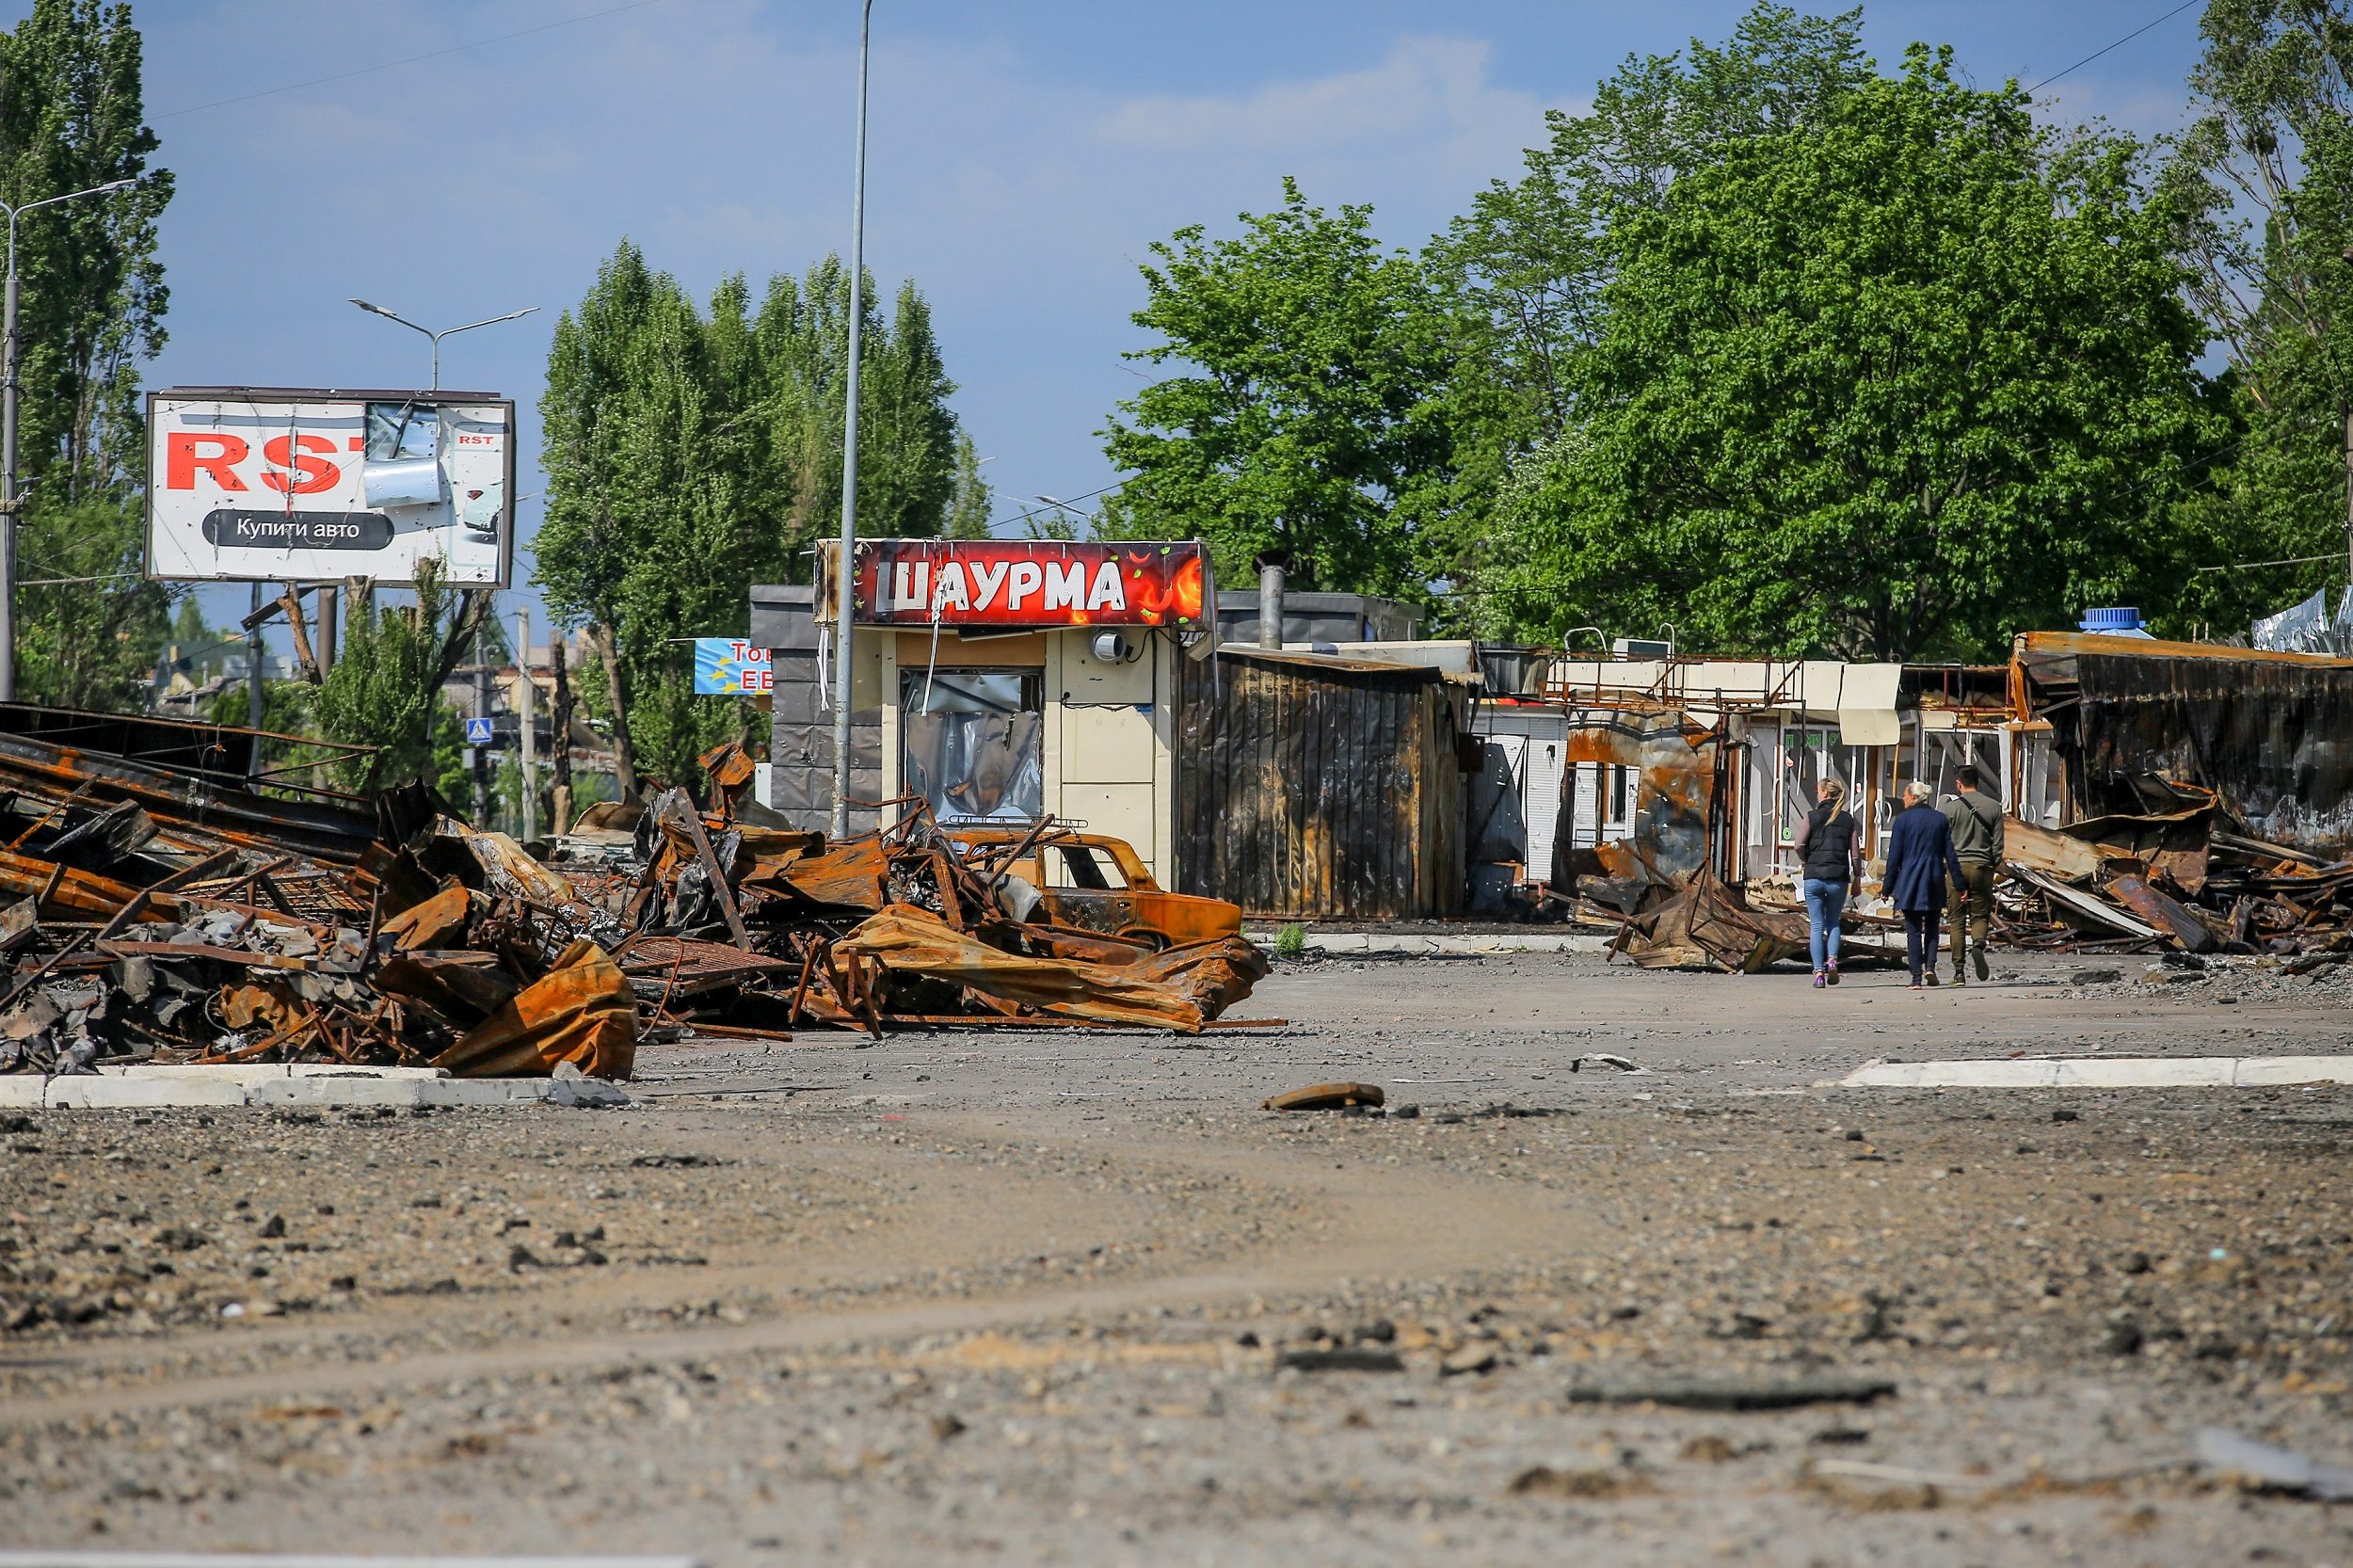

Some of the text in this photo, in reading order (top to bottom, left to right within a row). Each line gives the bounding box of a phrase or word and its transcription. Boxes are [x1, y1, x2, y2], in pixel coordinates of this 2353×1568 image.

[458, 436, 494, 445] RST
[167, 432, 364, 494] RS
[236, 518, 360, 539] Купити авто
[875, 560, 1127, 613] ШАУРМА
